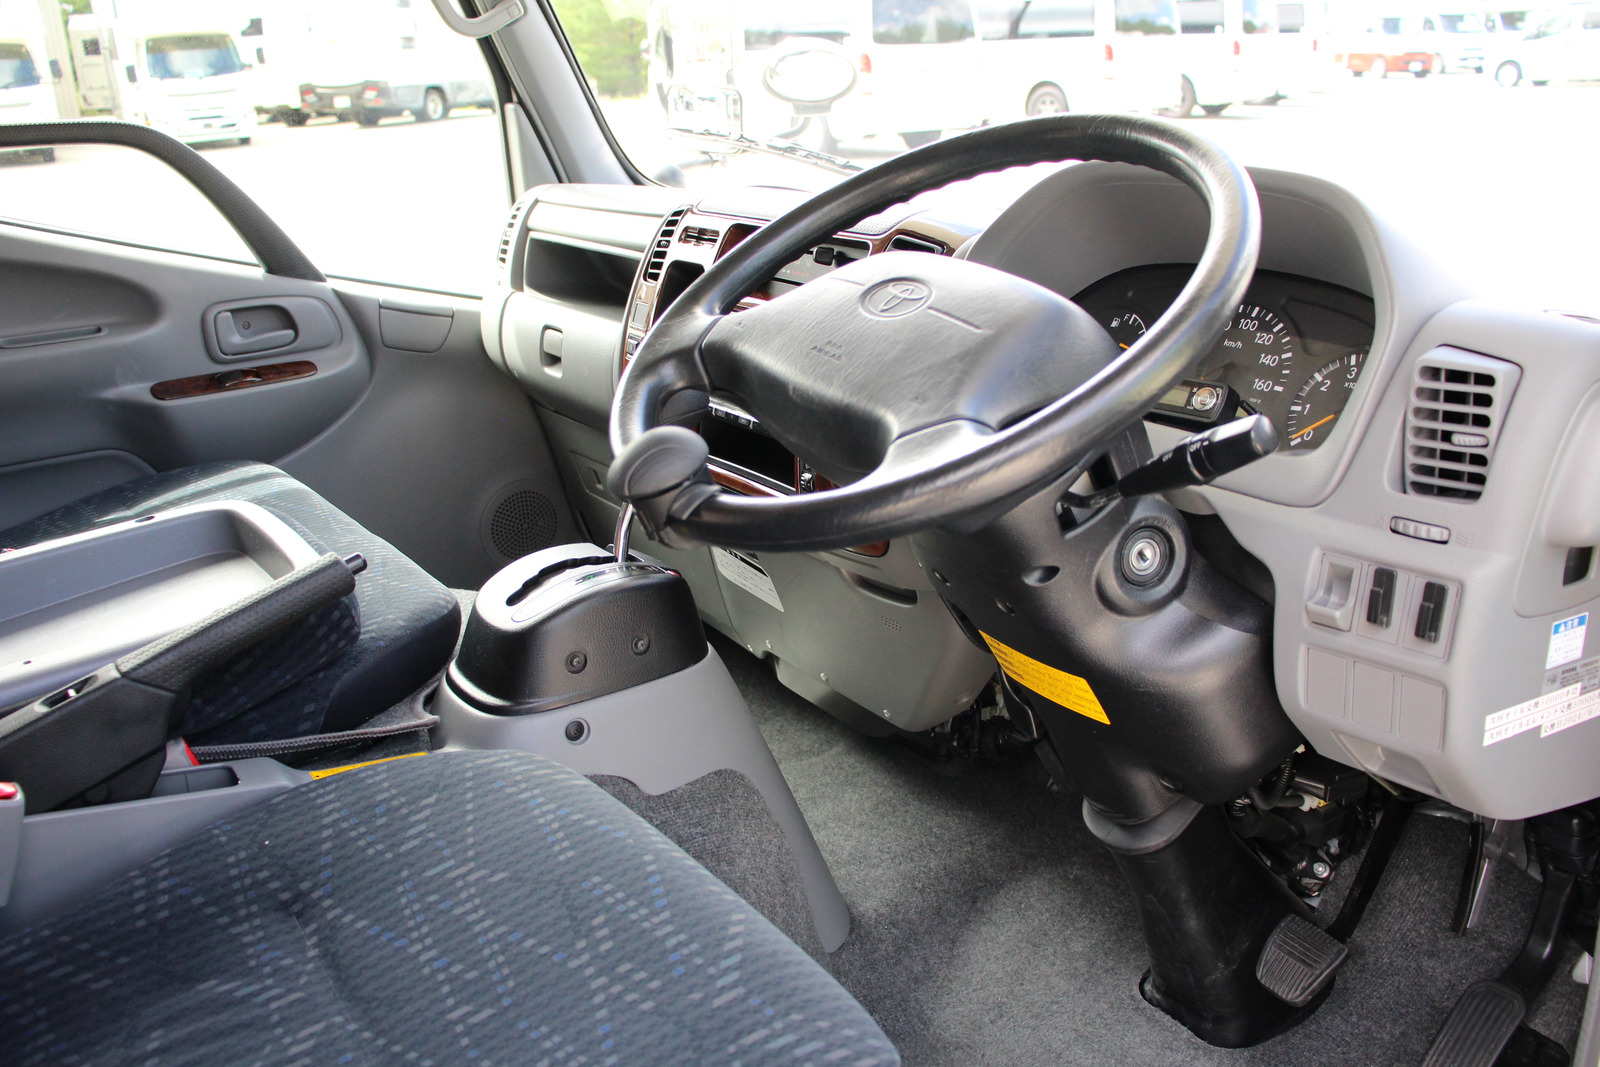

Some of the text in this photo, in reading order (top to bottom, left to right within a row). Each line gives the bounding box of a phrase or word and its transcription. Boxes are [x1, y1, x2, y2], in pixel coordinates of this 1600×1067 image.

[1123, 313, 1131, 321] F
[1238, 318, 1259, 332] 100
[1223, 338, 1243, 349] km/h
[1254, 332, 1274, 346] 120
[1258, 353, 1279, 367] 140
[1346, 367, 1358, 379] 3
[1252, 378, 1273, 392] 160
[1319, 379, 1331, 392] 2
[1303, 404, 1311, 415] 1
[1303, 429, 1314, 441] 0
